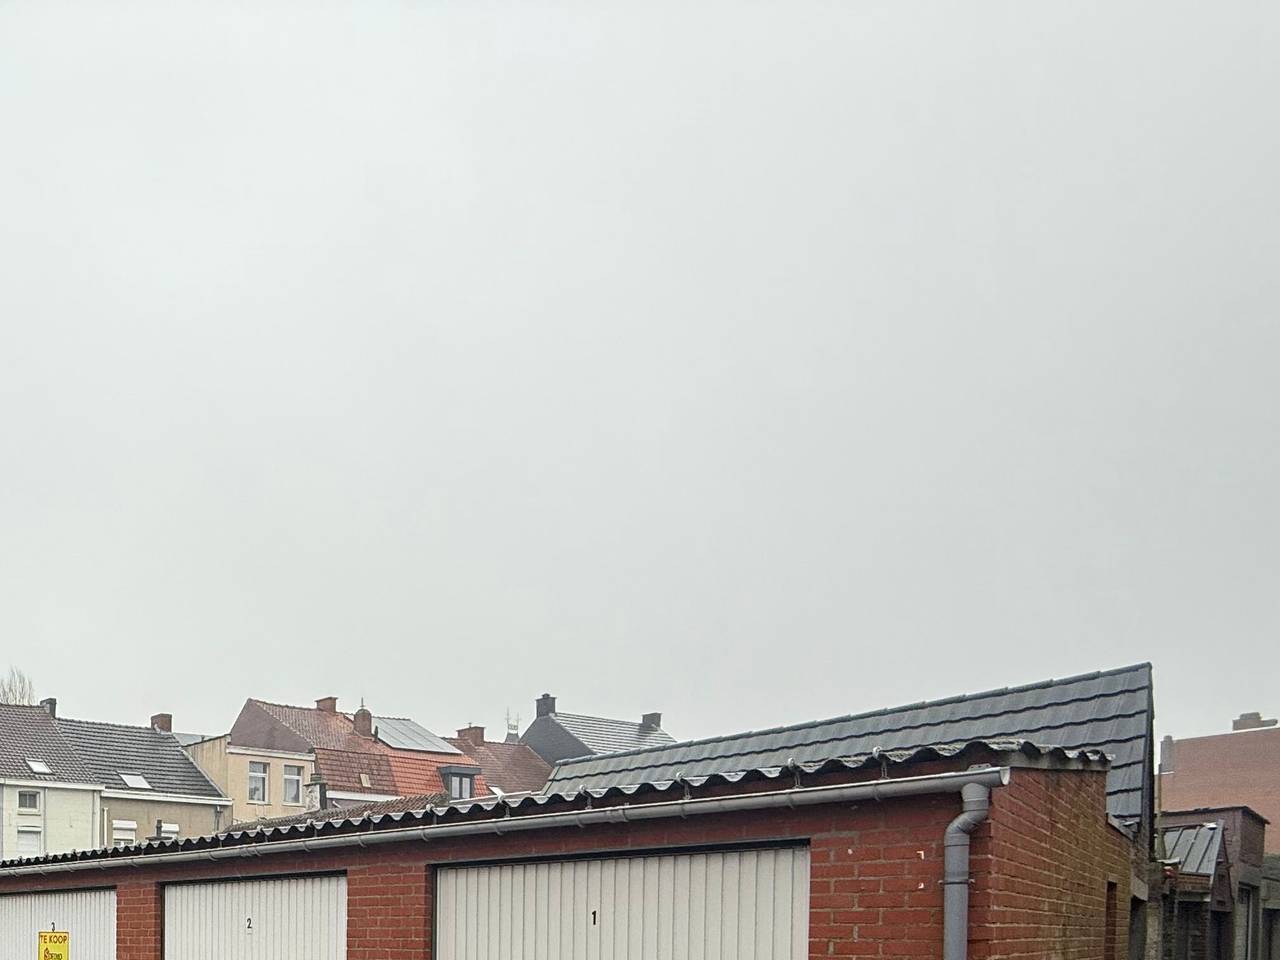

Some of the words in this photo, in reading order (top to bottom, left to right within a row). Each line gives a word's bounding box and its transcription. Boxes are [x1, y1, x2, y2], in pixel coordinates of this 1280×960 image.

[246, 918, 252, 928] 2
[592, 911, 597, 925] 1
[40, 935, 47, 944] TE
[49, 935, 68, 944] KOOP
